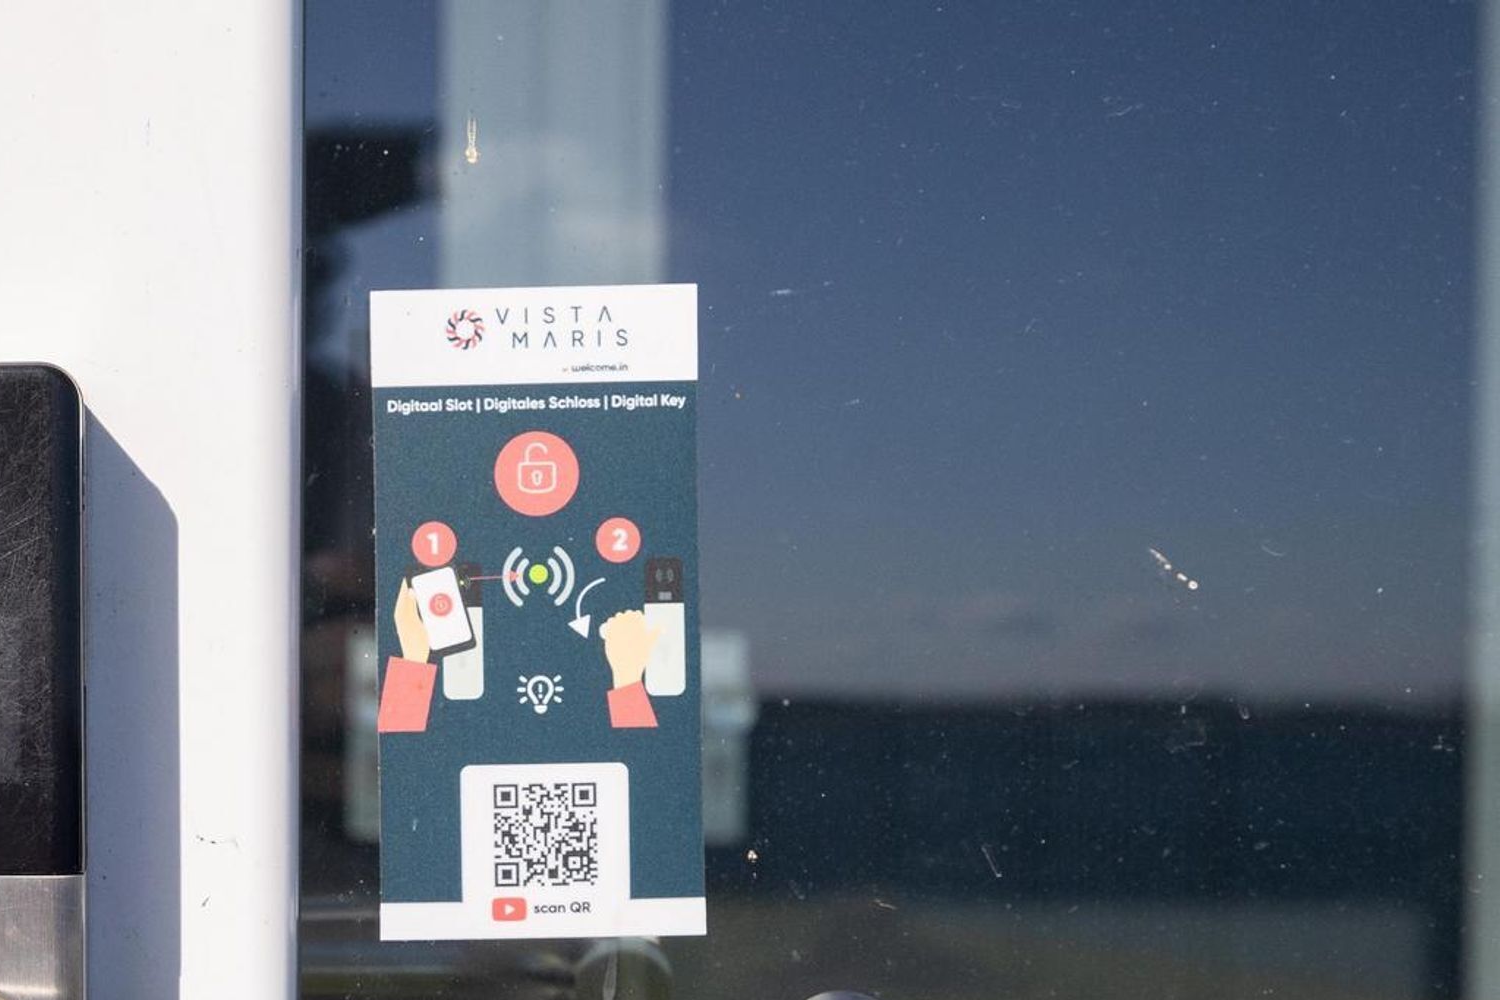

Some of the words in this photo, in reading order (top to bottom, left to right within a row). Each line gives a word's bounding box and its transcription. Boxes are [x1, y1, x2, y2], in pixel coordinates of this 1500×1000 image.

[496, 306, 612, 324] VISTA
[512, 329, 629, 348] MARIS
[387, 399, 442, 415] Digitaal
[445, 398, 473, 411] Slot
[484, 396, 546, 413] Digitales
[548, 395, 600, 409] Schloss
[611, 394, 657, 410] Digital
[661, 394, 686, 409] Key
[426, 532, 439, 554] 1
[612, 528, 628, 550] 2
[534, 903, 566, 913] scan
[570, 901, 591, 913] QR
